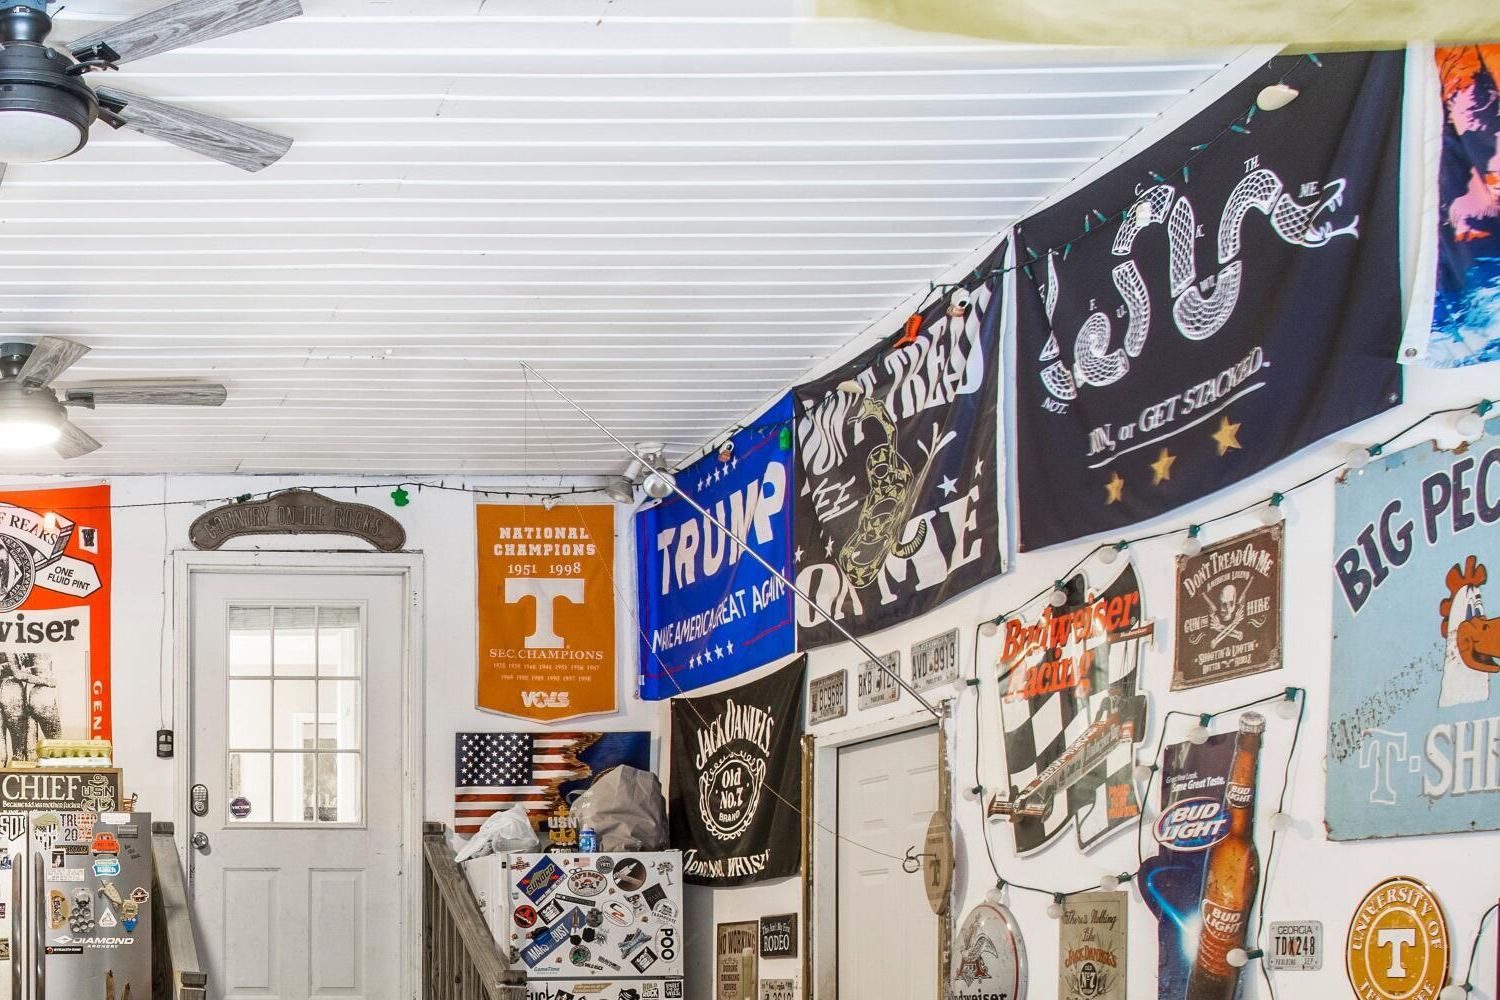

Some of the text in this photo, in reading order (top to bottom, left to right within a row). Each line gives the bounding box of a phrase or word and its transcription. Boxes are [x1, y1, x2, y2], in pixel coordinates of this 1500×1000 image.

[1139, 394, 1182, 433] GET
[9, 513, 58, 546] REARS
[204, 504, 383, 540] COUNTRY ON THE ROCKS
[657, 461, 787, 596] TRUMP
[499, 526, 590, 540] NATIONAL
[493, 543, 597, 556] CHAMPIONS
[1334, 499, 1415, 615] BIG
[54, 566, 74, 577] ONE
[507, 561, 581, 577] 1951 1998
[1183, 543, 1274, 599] DON'T TREAD ON ME
[47, 572, 91, 591] FLUID PINT
[504, 577, 585, 649] T
[1246, 596, 1270, 616] HIRE
[1000, 590, 1140, 663] Budweiser
[1184, 617, 1201, 633] GUN
[489, 648, 604, 661] SEC CHAMPIONS
[911, 651, 928, 681] AVD
[520, 690, 570, 708] VOLS
[696, 714, 722, 770] JACK
[1, 774, 81, 800] CHIEF
[721, 767, 742, 788] Old
[1189, 777, 1206, 789] Great
[81, 786, 115, 797] USN
[1227, 790, 1252, 802] LIGHT
[1230, 783, 1251, 795] BUD
[718, 810, 741, 823] BRAND
[1172, 801, 1221, 823] BUD
[547, 816, 579, 829] USN
[1161, 818, 1228, 842] LIGHT
[526, 862, 557, 896] SUNOCO
[1090, 908, 1118, 930] Nothing
[1211, 907, 1242, 924] BUD
[1352, 886, 1444, 951] UNIVERSITY OF
[551, 923, 570, 943] BUST
[1205, 916, 1243, 935] LIGHT
[1277, 925, 1314, 936] GEORGIA
[72, 937, 135, 945] DIAMOND
[660, 927, 675, 961] POO
[717, 929, 757, 955] NO WORKING
[763, 933, 790, 952] RODEO
[1377, 927, 1417, 979] T
[721, 973, 740, 982] DRINKING
[722, 964, 738, 973] DURING
[641, 990, 659, 999] ROCK
[642, 983, 658, 991] BOLD
[723, 983, 737, 991] HOURS
